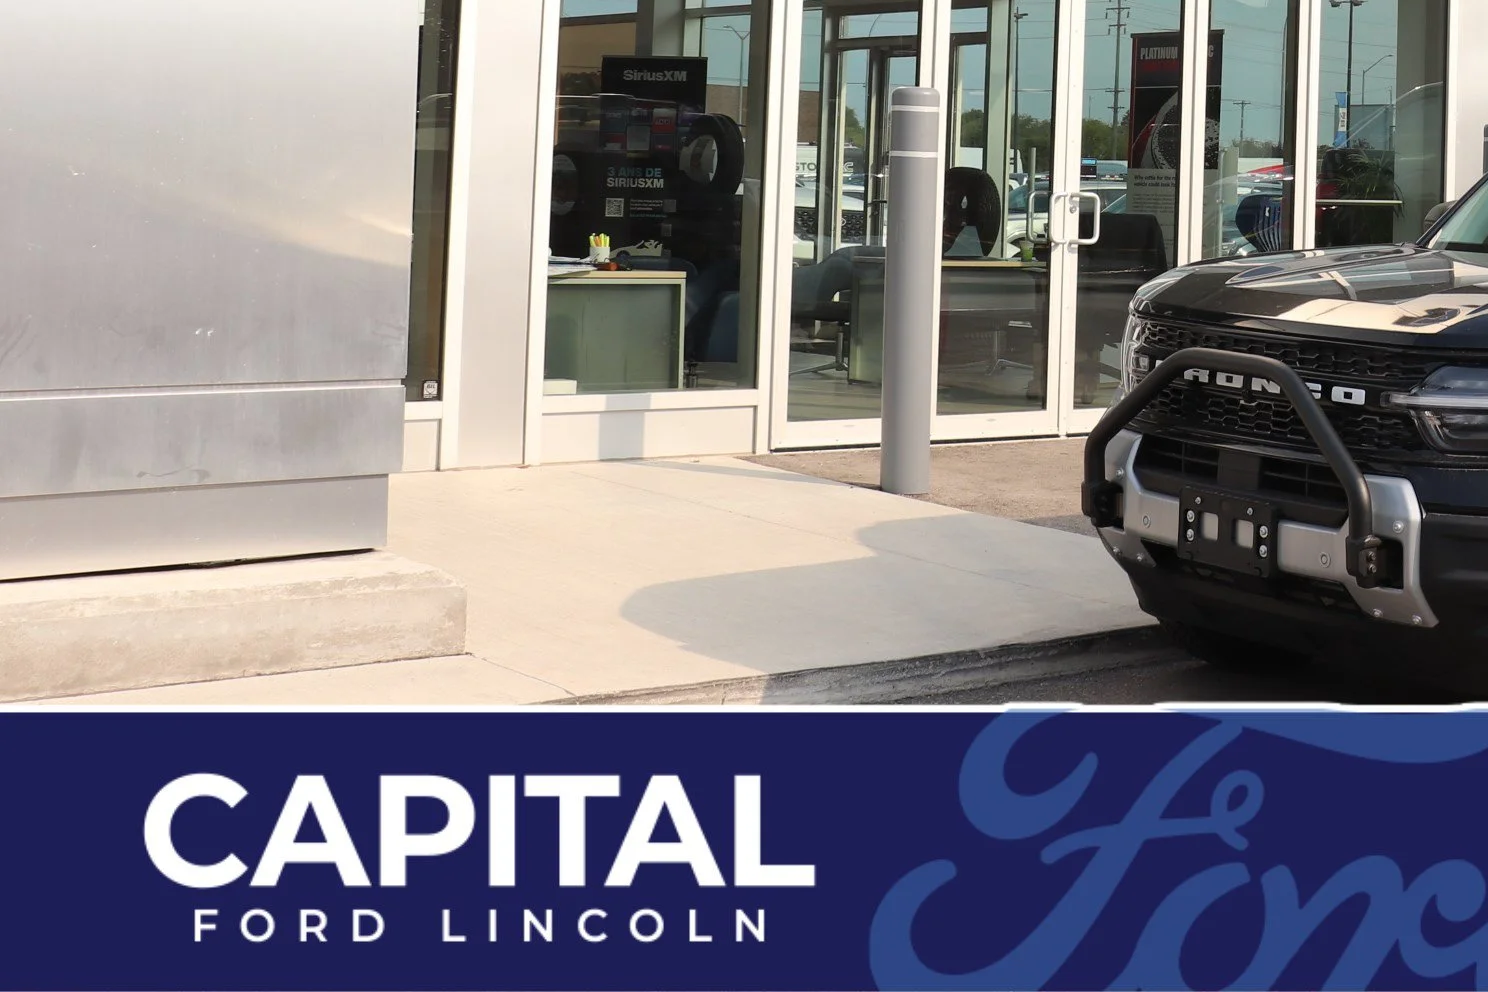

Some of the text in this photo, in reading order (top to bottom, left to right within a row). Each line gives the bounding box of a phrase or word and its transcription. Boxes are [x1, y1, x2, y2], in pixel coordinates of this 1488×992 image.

[1140, 46, 1178, 60] PLATINUM
[623, 69, 688, 82] SiriusXM
[607, 167, 616, 177] 3
[645, 168, 662, 177] DE
[606, 178, 664, 188] SIRIUSXM
[1155, 360, 1366, 405] RONO
